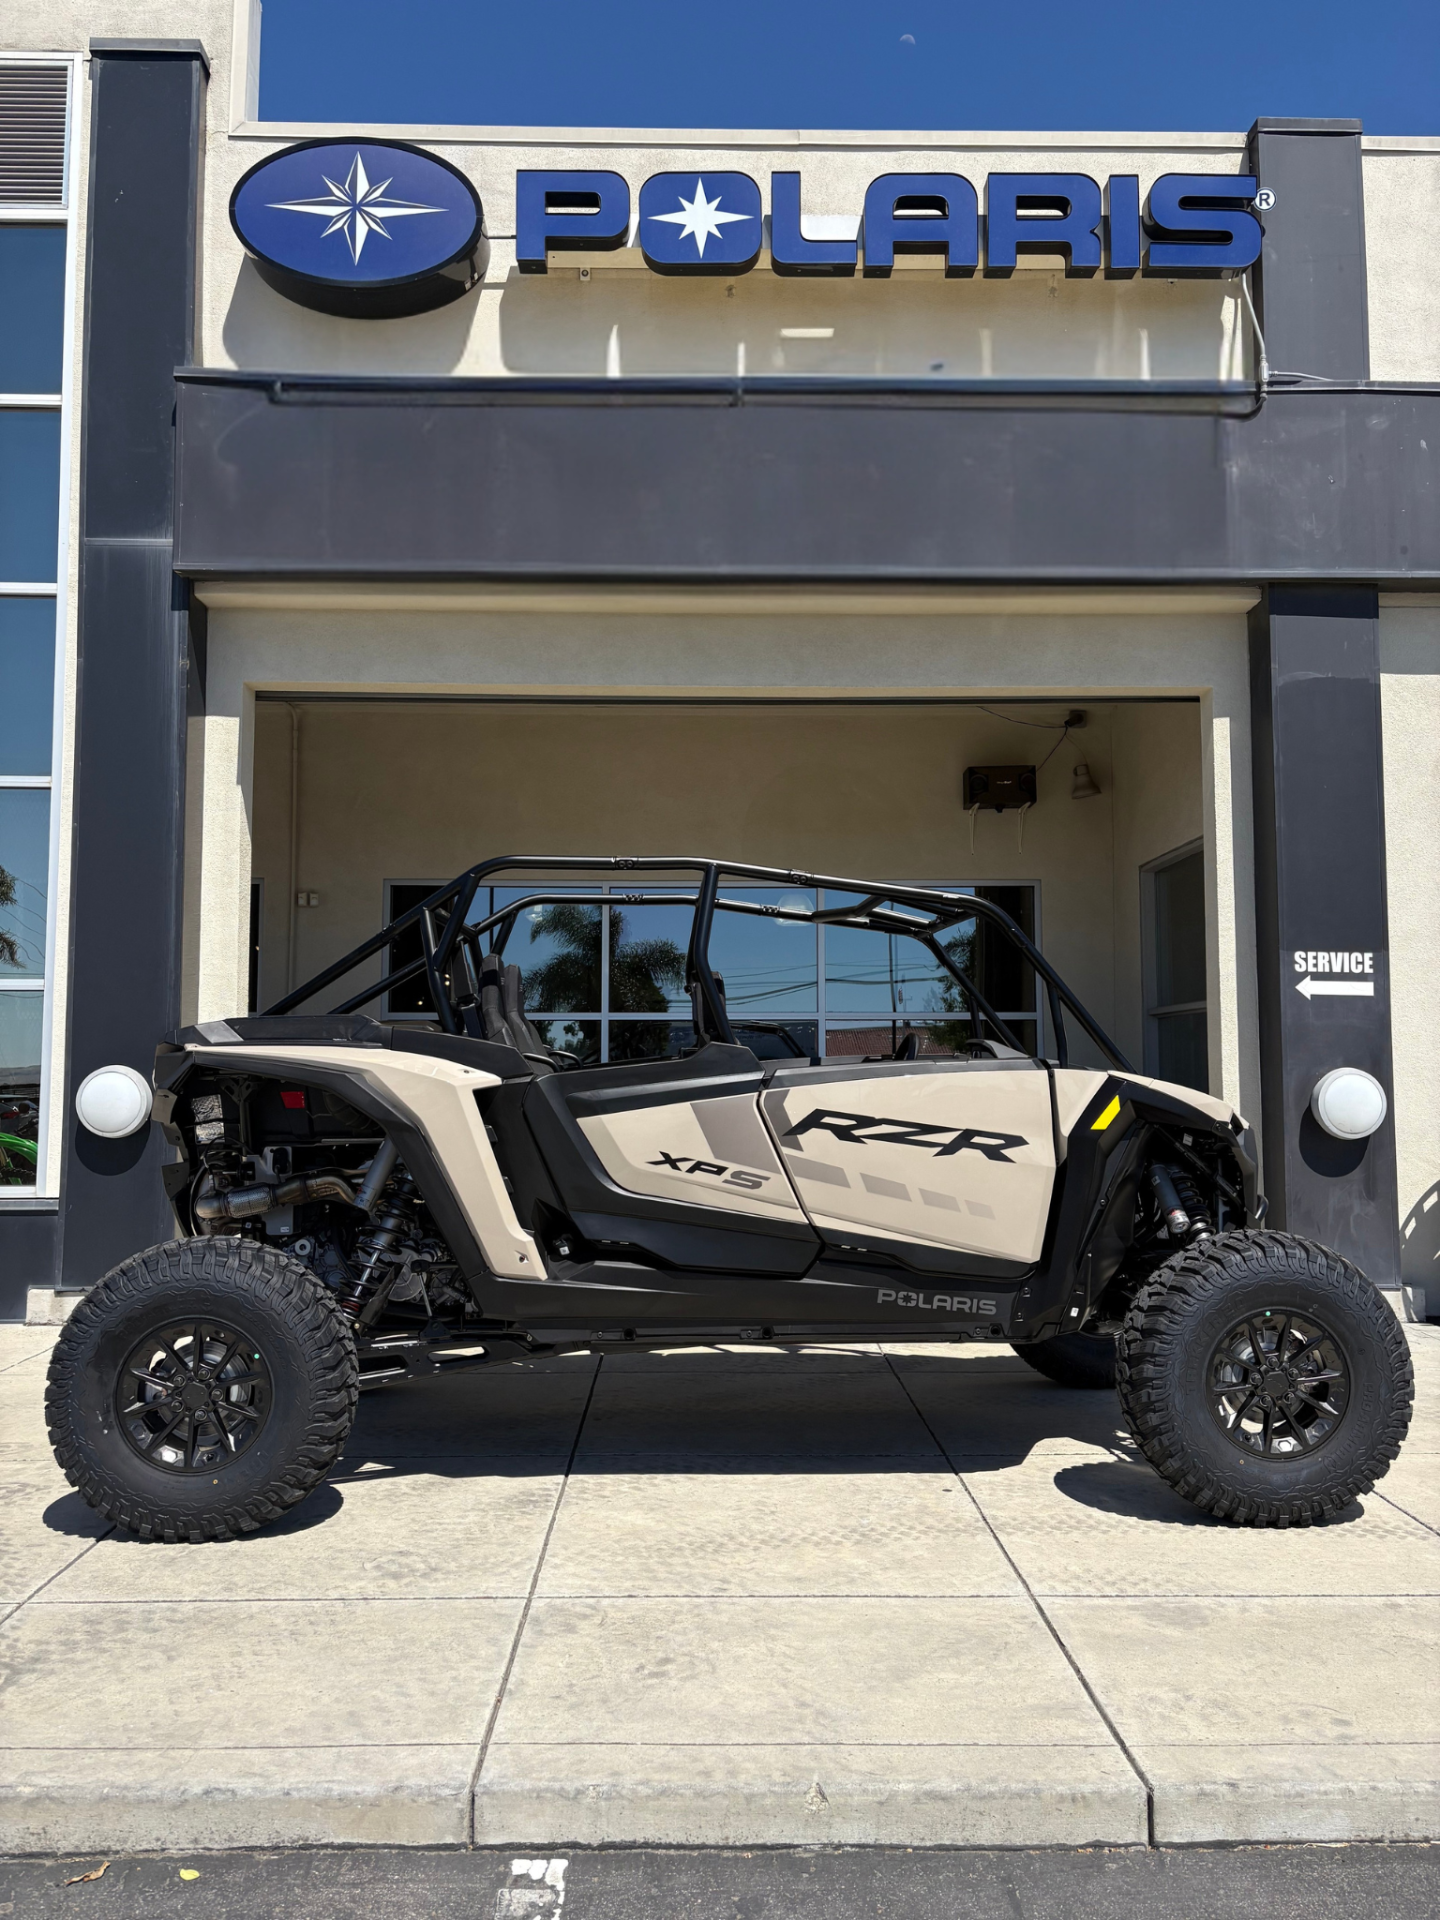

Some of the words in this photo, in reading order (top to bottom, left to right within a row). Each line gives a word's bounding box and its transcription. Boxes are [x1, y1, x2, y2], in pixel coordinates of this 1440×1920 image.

[1294, 951, 1373, 973] SERVICE
[782, 1108, 1030, 1163] RZR
[877, 1289, 997, 1315] POLARIS
